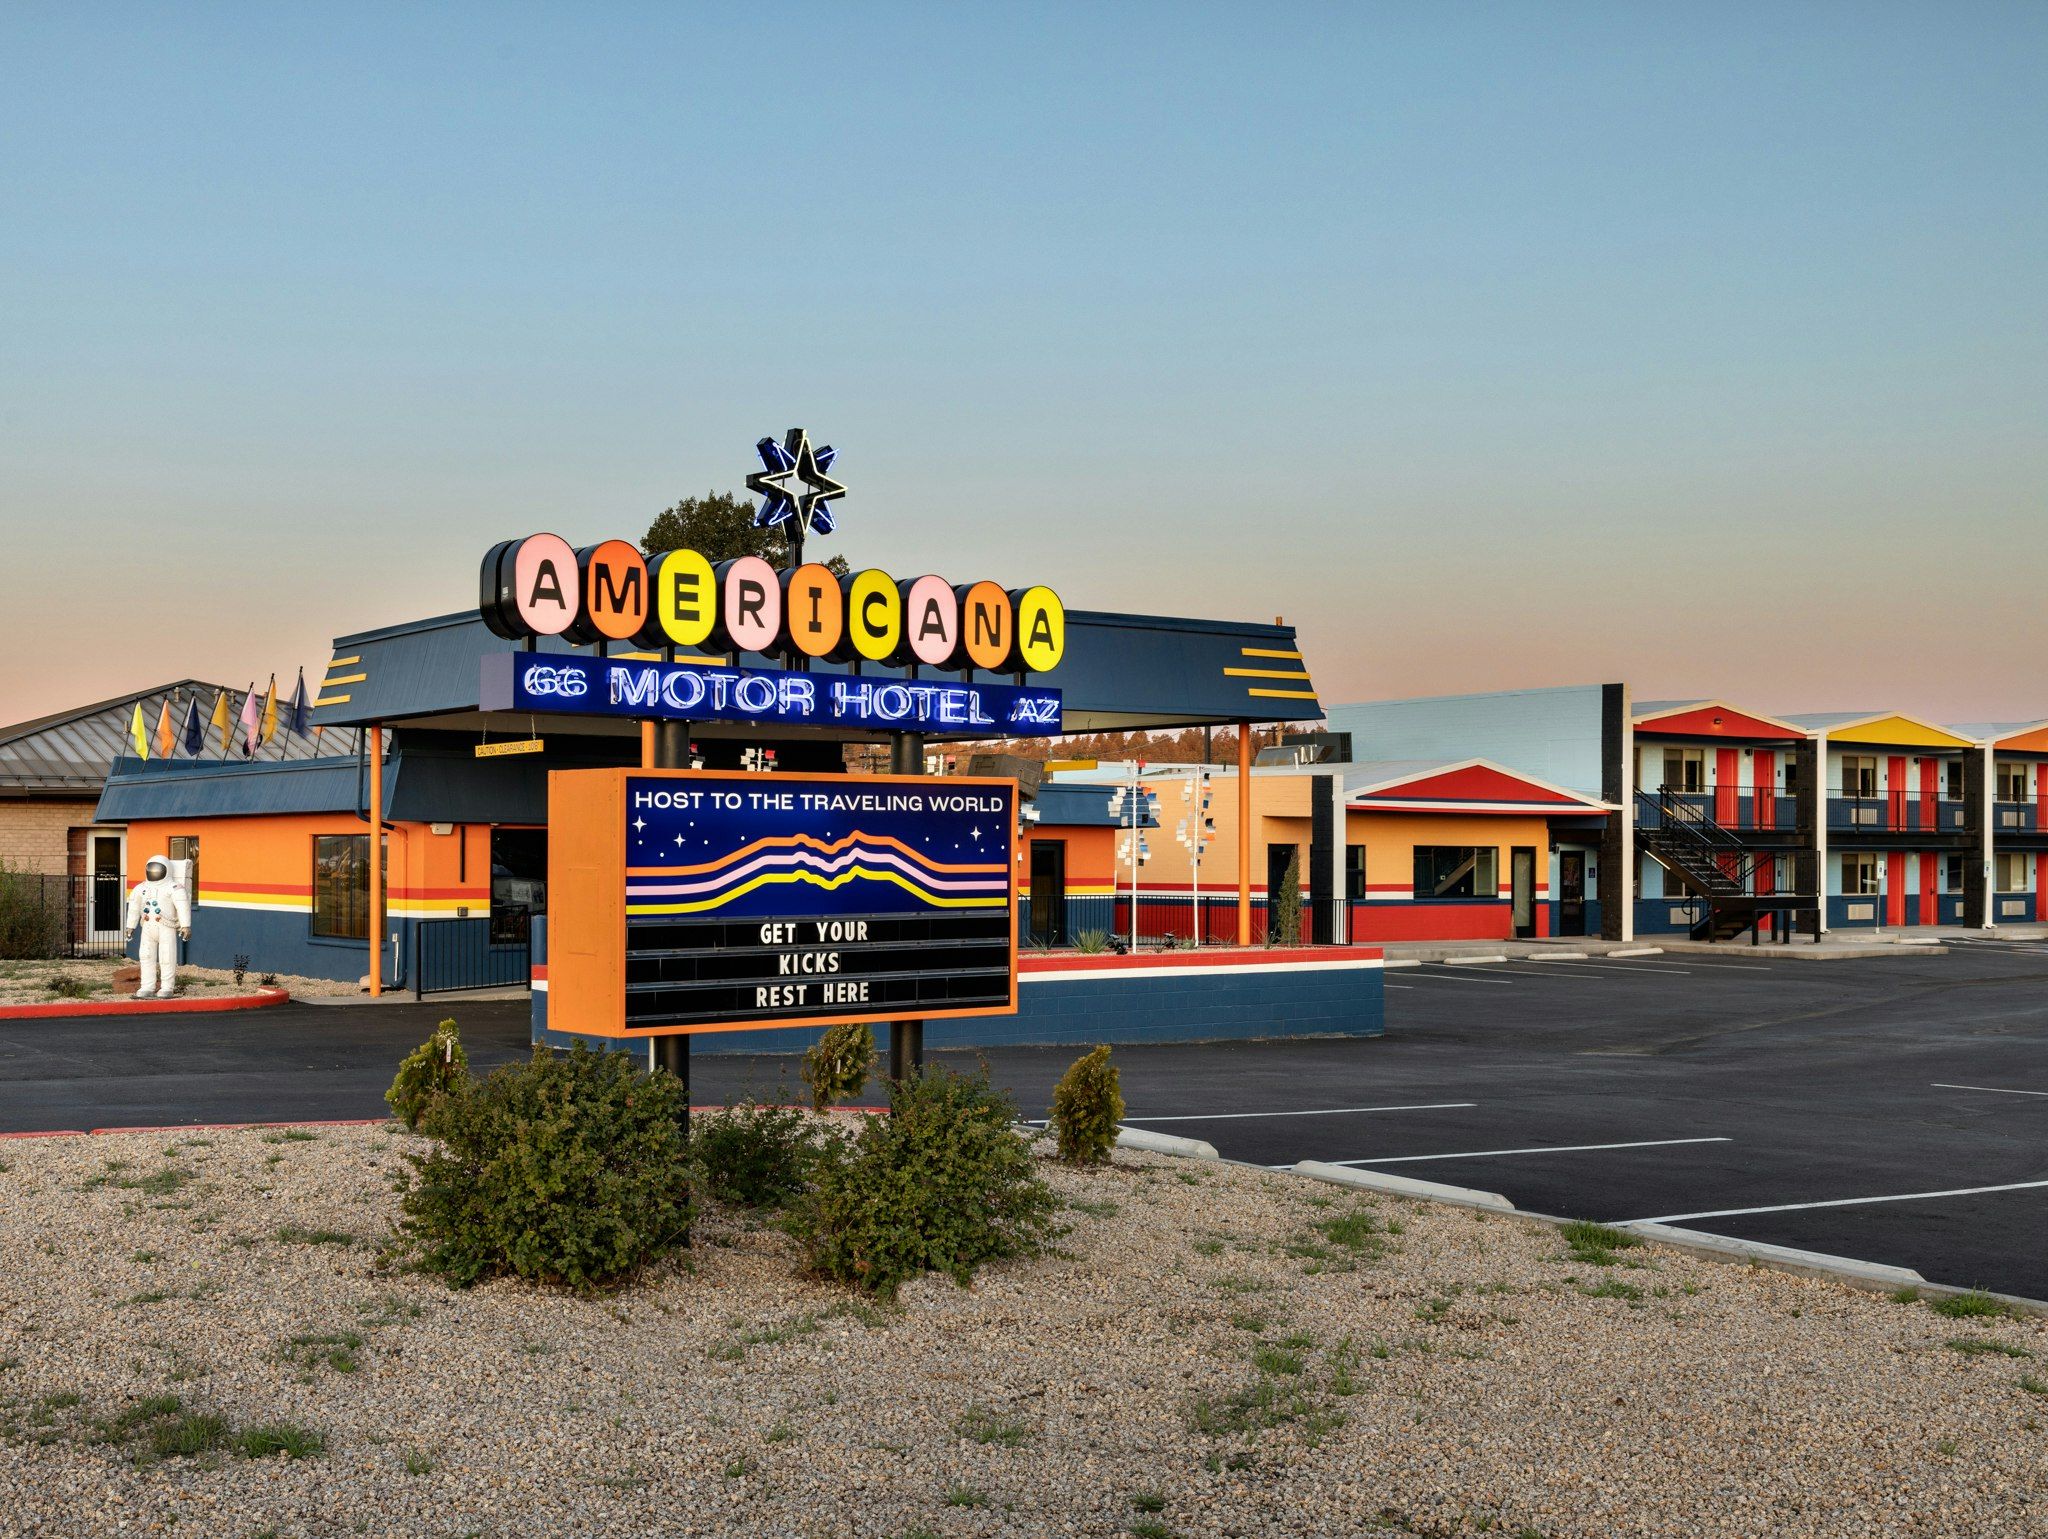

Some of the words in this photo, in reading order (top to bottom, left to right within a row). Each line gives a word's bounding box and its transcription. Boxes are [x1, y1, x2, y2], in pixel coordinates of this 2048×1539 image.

[528, 558, 1055, 652] AMERICANA
[524, 665, 588, 698] 66
[610, 667, 815, 716] MOTOR
[833, 681, 995, 725] HOTEL
[1010, 697, 1060, 724] AZ
[635, 791, 704, 809] HOST
[711, 792, 742, 810] TO
[748, 793, 794, 810] THE
[800, 794, 923, 811] TRAVELING
[929, 796, 1004, 812] WORLD
[760, 923, 796, 944] GET
[816, 921, 868, 942] YOUR
[779, 952, 839, 975] KICKS
[756, 984, 807, 1008] REST
[823, 982, 869, 1004] HERE
